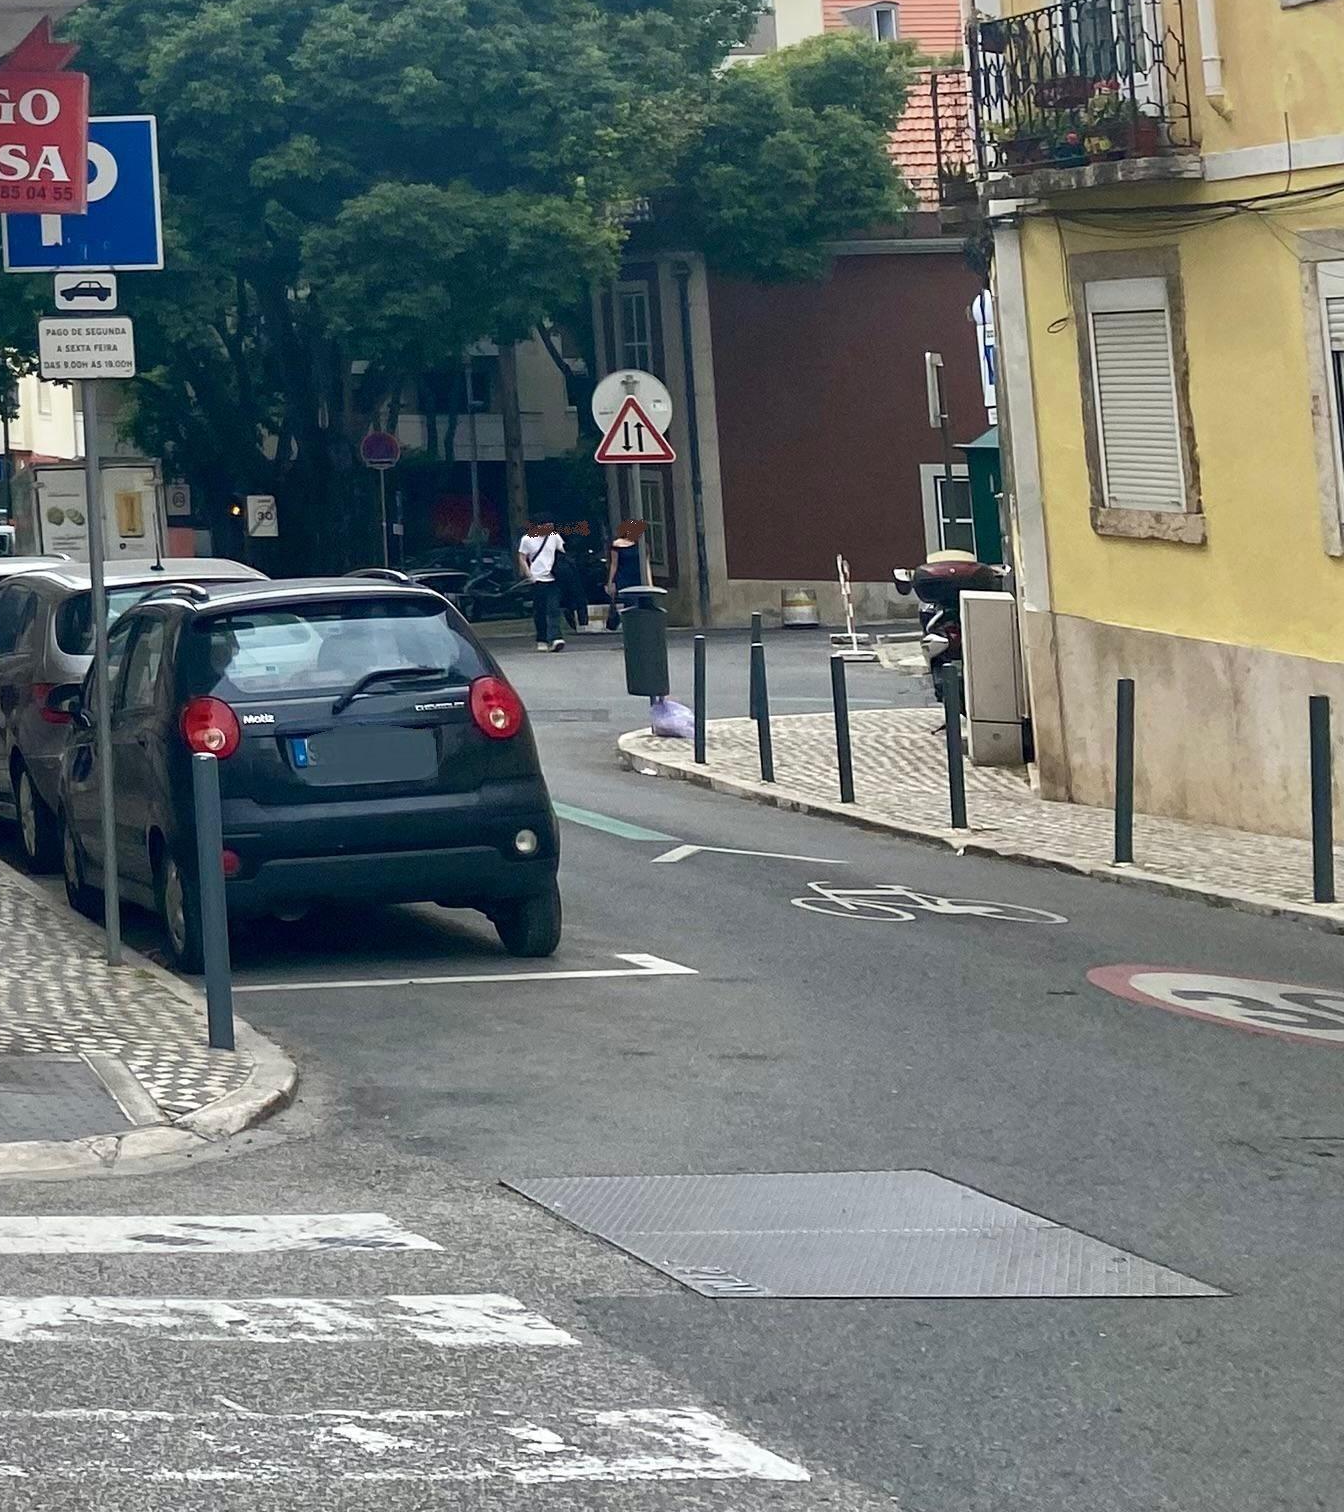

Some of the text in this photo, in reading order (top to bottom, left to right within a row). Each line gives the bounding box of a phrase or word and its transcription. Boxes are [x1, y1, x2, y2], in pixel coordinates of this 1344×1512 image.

[26, 186, 47, 201] 04
[52, 186, 74, 202] 55
[45, 327, 127, 336] PAGO DE SEGUNDA
[65, 344, 91, 353] SEXTA
[93, 344, 118, 352] FEIRA
[43, 361, 60, 369] DAS
[257, 511, 273, 521] 30
[243, 713, 276, 725] Matiz
